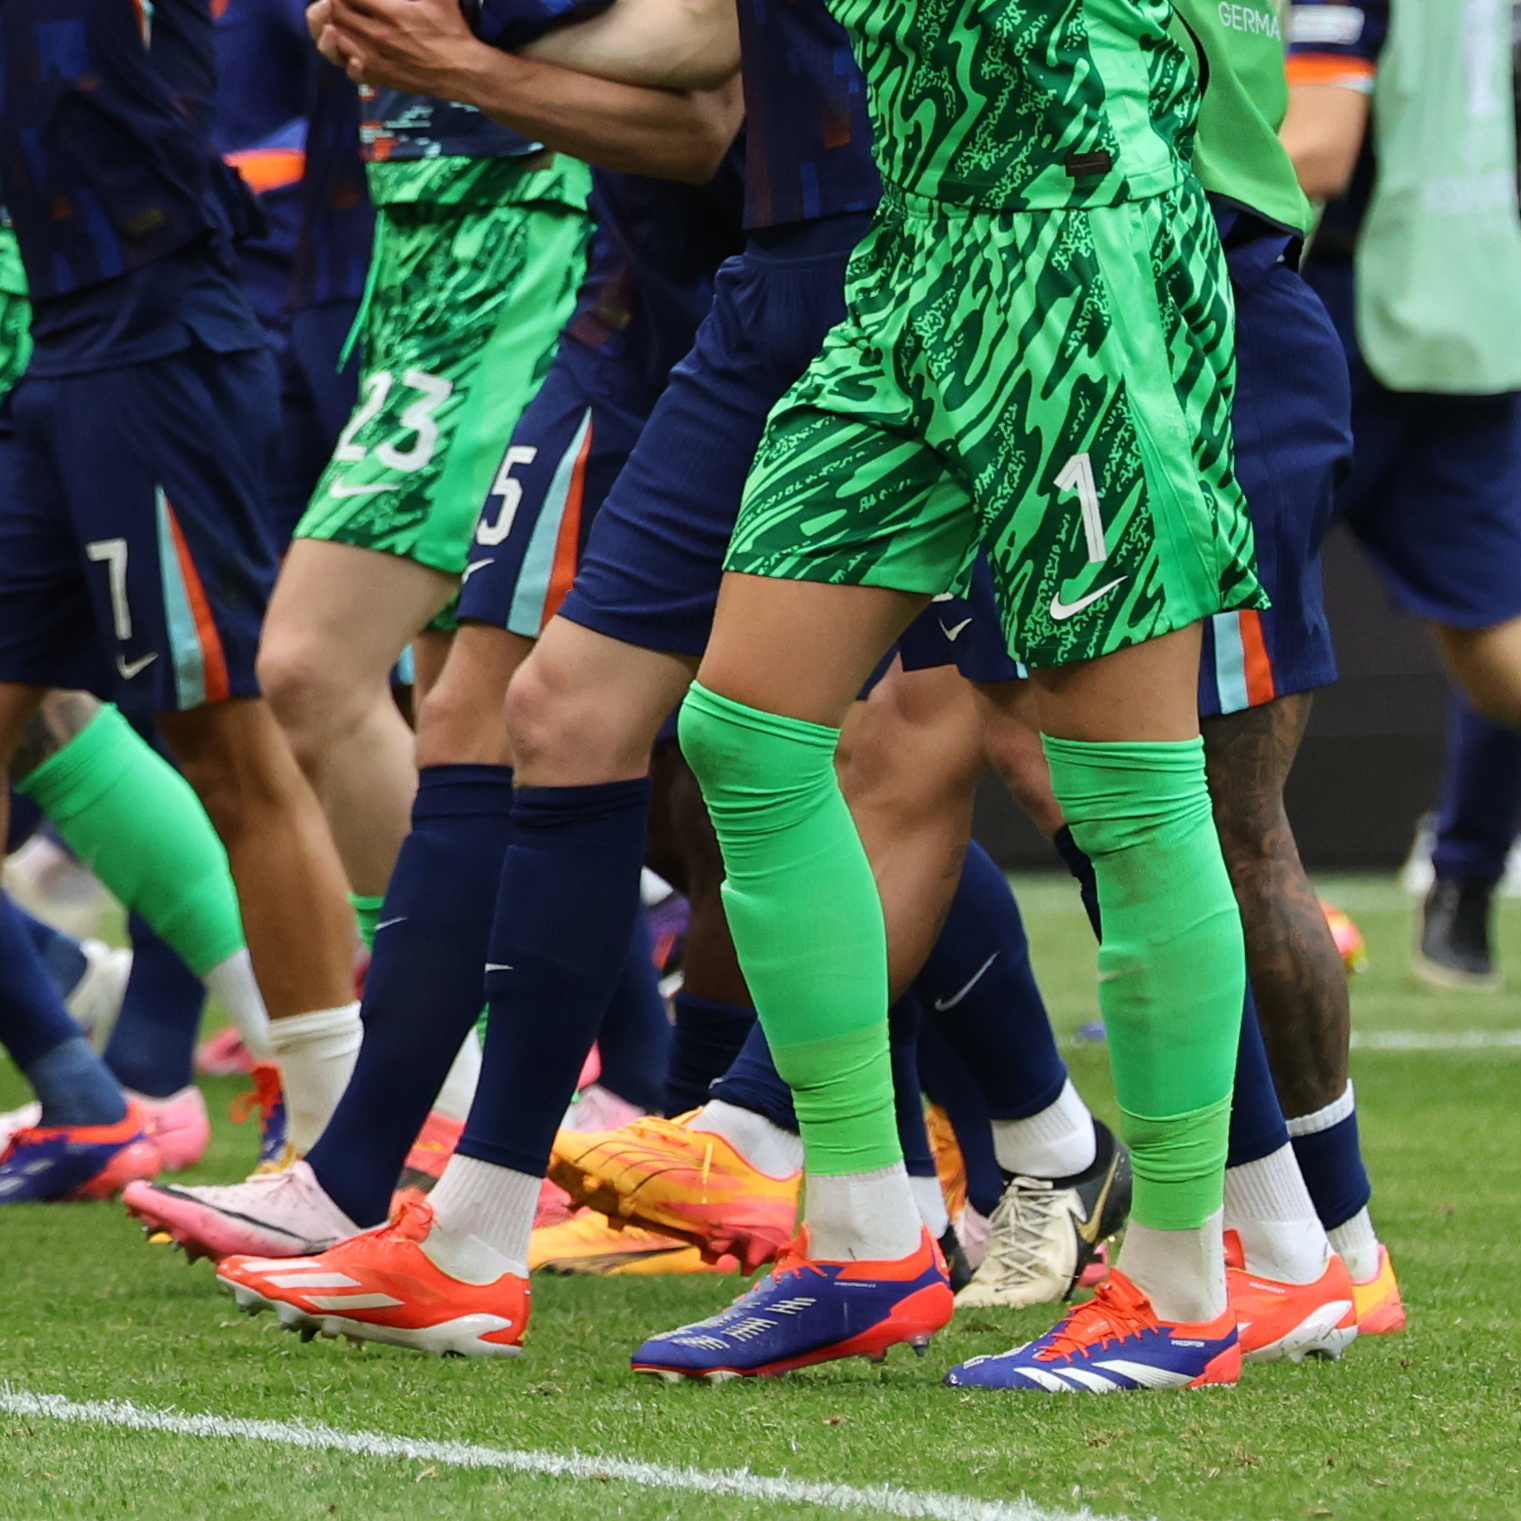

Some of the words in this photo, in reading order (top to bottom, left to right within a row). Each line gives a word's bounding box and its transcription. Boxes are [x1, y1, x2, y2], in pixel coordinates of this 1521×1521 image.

[333, 371, 454, 472] 23
[477, 446, 538, 546] 5
[1053, 453, 1108, 563] 1
[85, 537, 132, 640] 7
